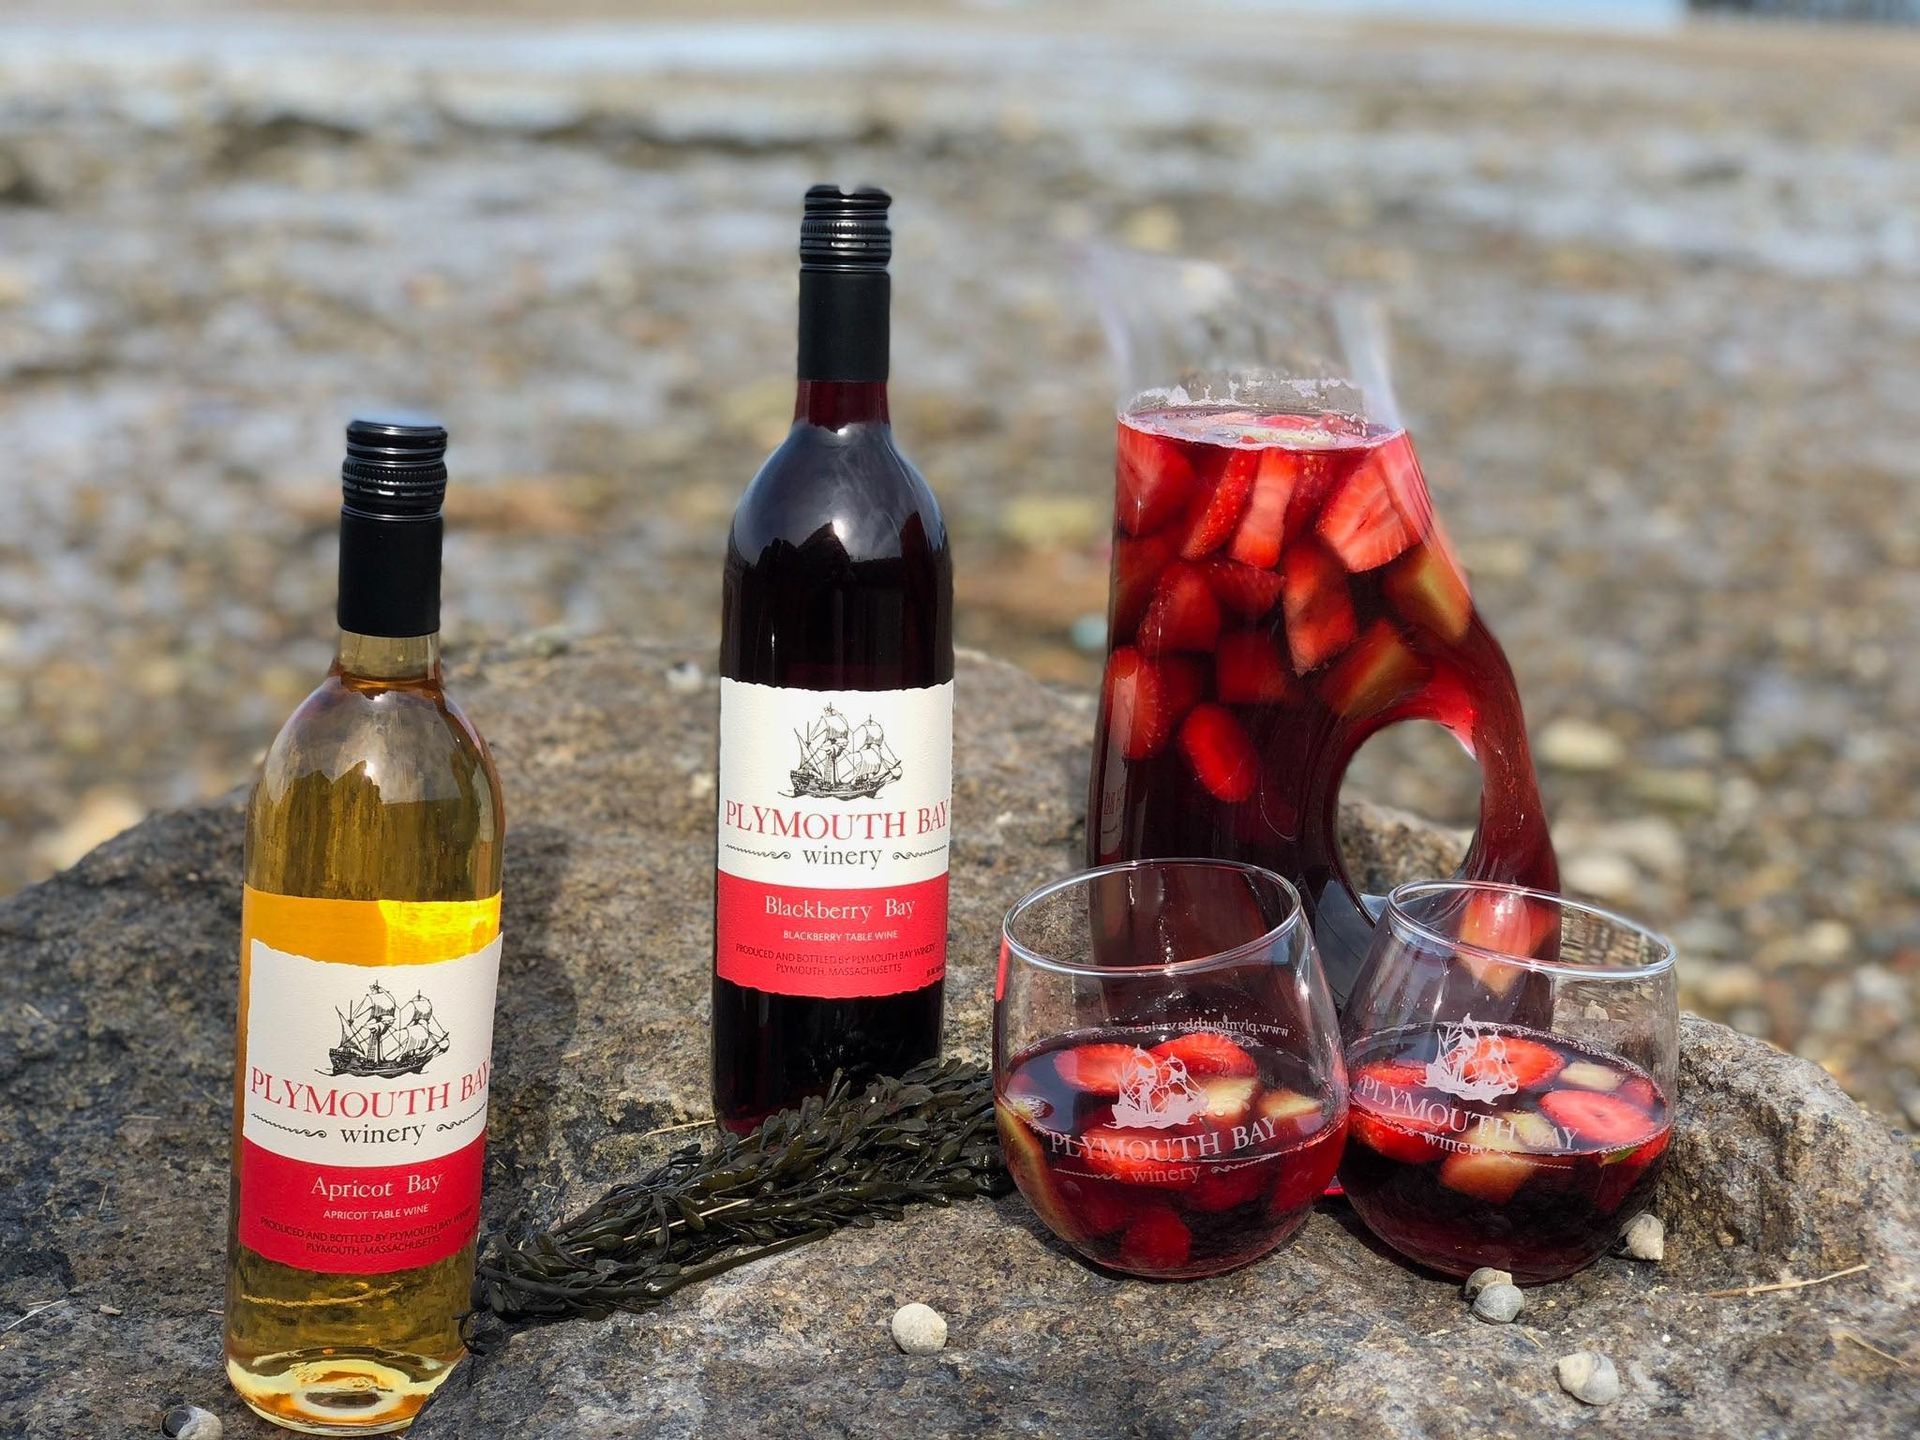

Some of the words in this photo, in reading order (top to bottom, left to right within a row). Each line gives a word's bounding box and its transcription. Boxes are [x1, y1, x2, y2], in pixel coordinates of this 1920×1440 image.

[725, 799, 906, 841] PLYMOUTH
[917, 799, 949, 834] BAY
[803, 845, 882, 870] winery
[765, 895, 872, 924] Blackberry
[885, 898, 915, 919] Bay
[783, 930, 842, 942] BLACKBERRY
[845, 932, 873, 942] TABLE
[875, 930, 899, 940] WINE
[736, 943, 775, 959] PRODUCED
[776, 952, 795, 962] AND
[797, 954, 837, 964] BOTTLED
[838, 955, 850, 964] BY
[851, 952, 898, 964] PLYMOUTH
[899, 949, 914, 960] BAY
[828, 963, 902, 976] MASSACHUSETTS
[252, 1066, 451, 1118] PLYMOUTH
[1361, 1074, 1516, 1143] PLYMOUTH
[341, 1123, 426, 1146] winery
[1051, 1130, 1222, 1163] PLYMOUTH
[1231, 1115, 1277, 1150] BAY
[1424, 1133, 1493, 1156] winery
[1131, 1166, 1201, 1184] winery
[310, 1175, 394, 1202] Apricot
[407, 1173, 443, 1195] Bay
[323, 1210, 369, 1221] APRICOT
[371, 1208, 401, 1220] TABLE
[403, 1203, 430, 1217] WINE
[261, 1217, 304, 1238] PRODUCED
[305, 1231, 328, 1242] AND
[329, 1233, 374, 1244] BOTTLED
[375, 1232, 387, 1242] BY
[389, 1223, 438, 1240] PLYMOUTH
[363, 1235, 441, 1255] MASSACHUSETTS
